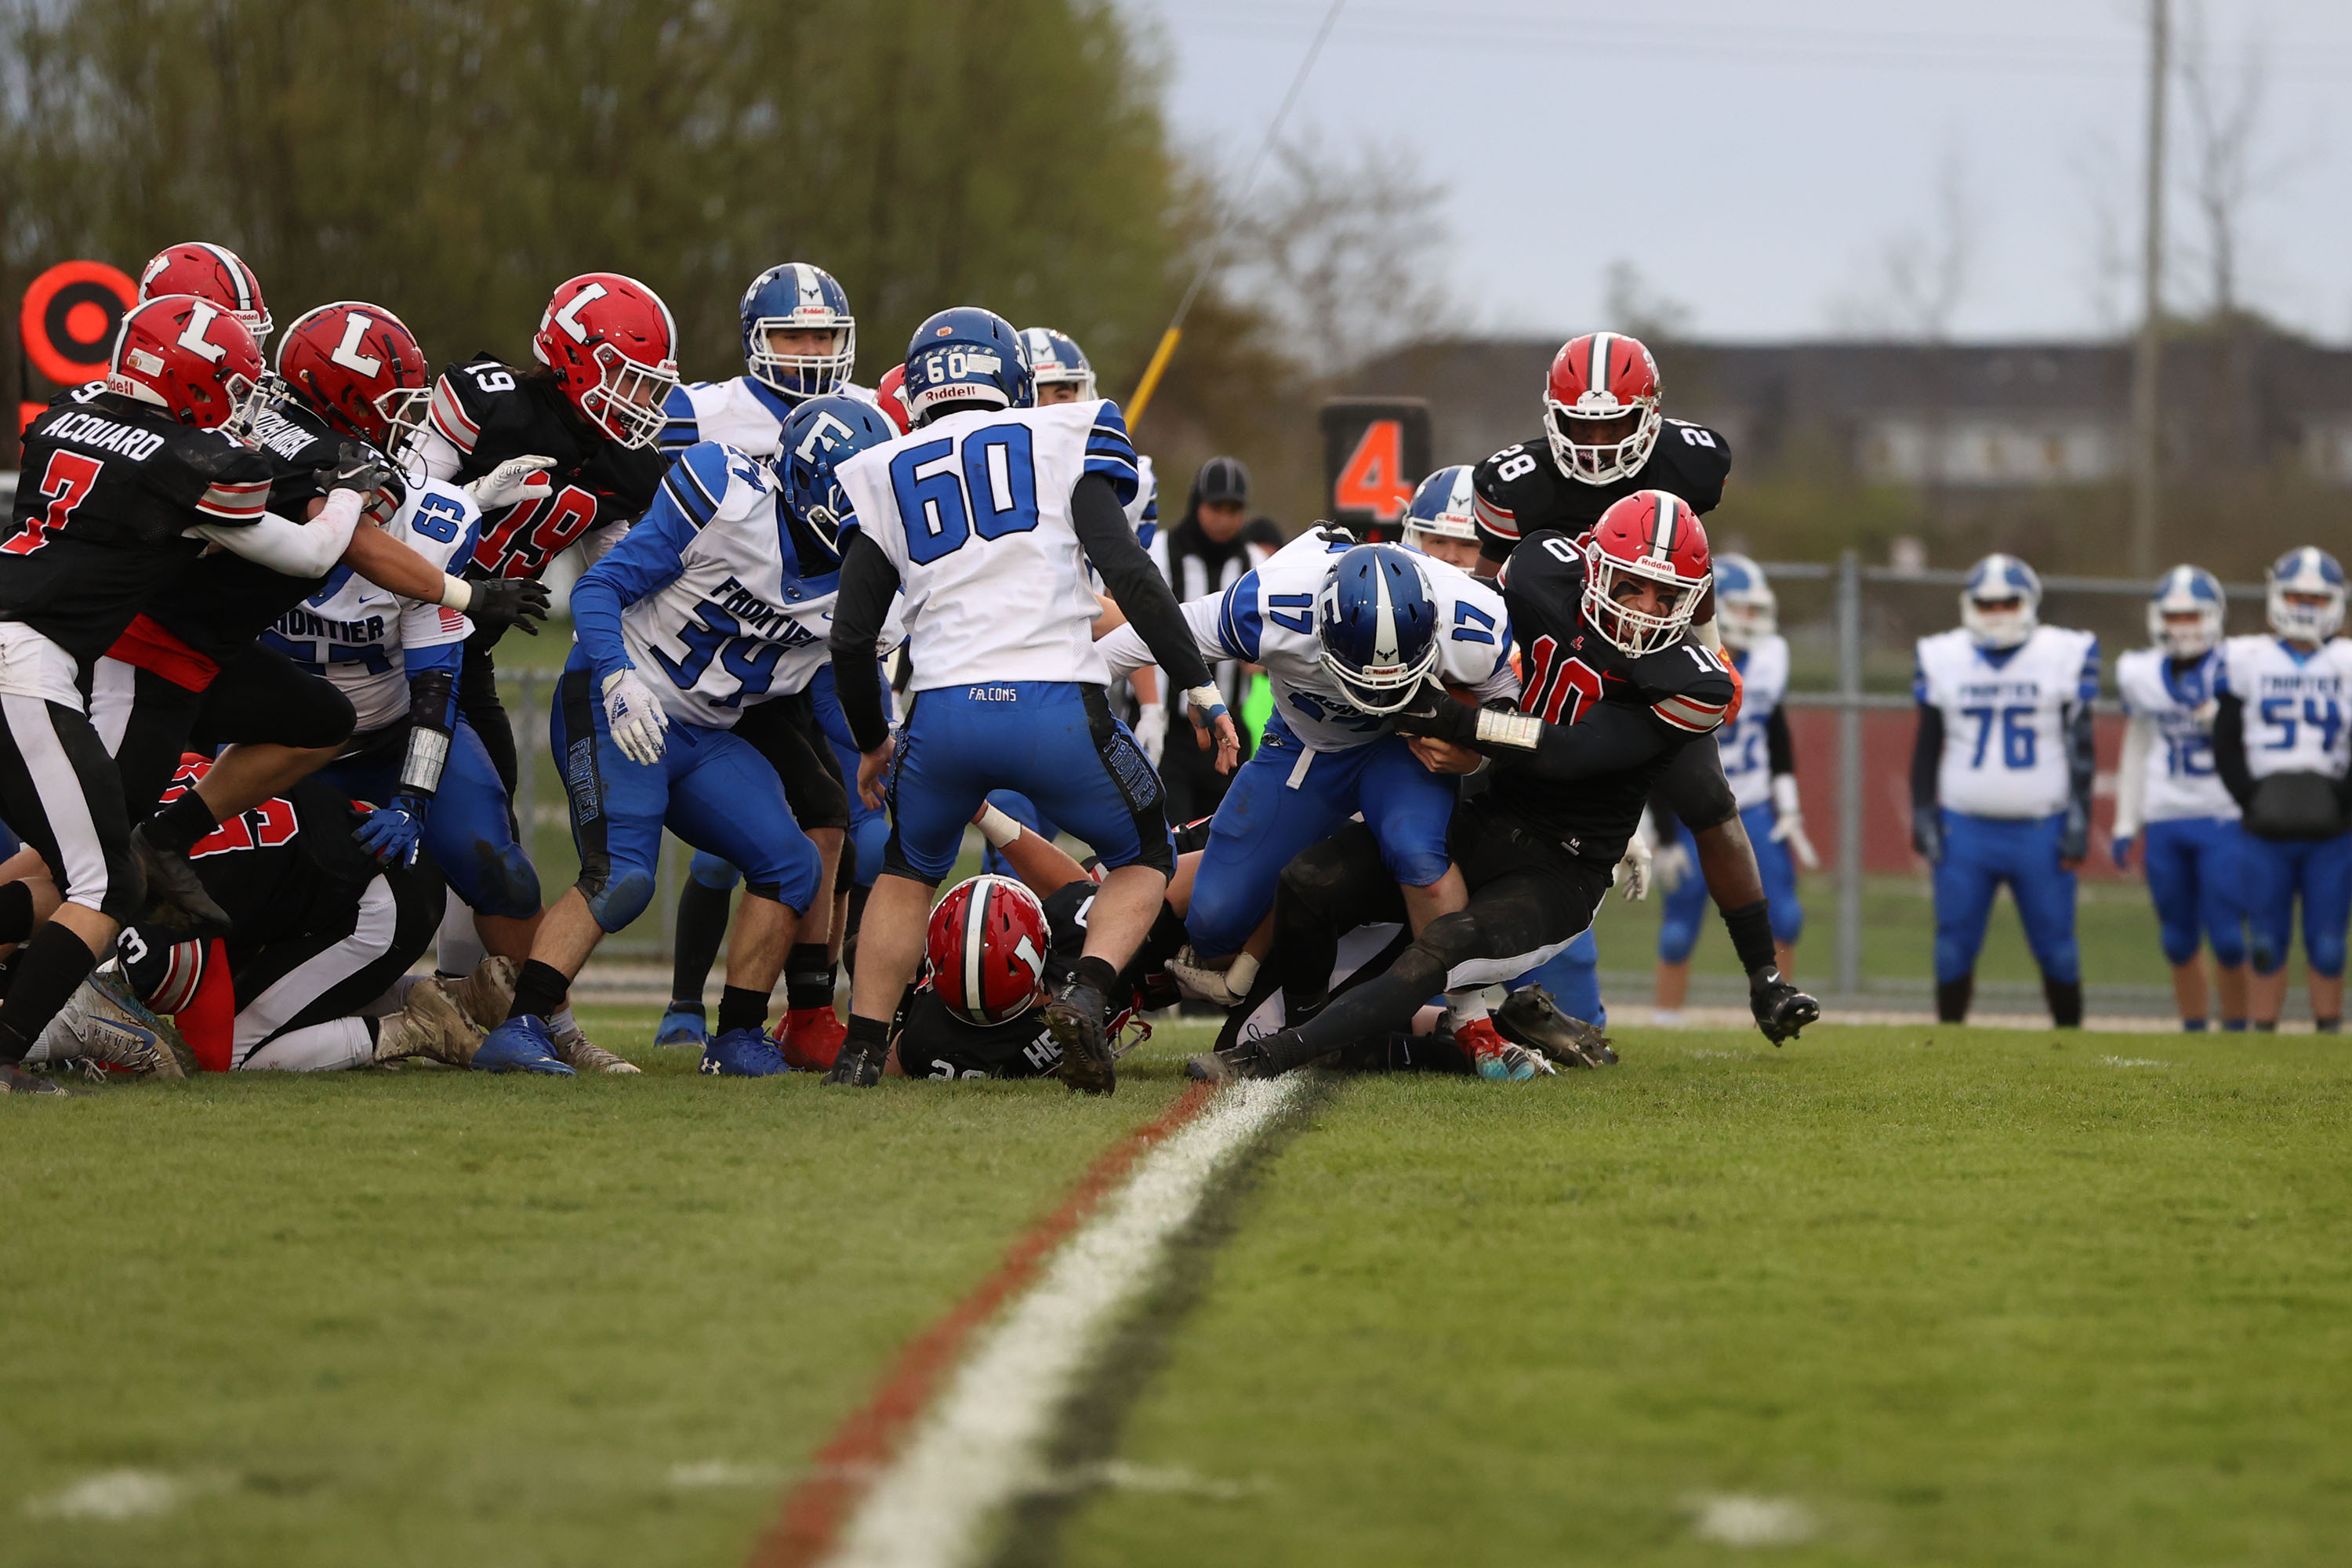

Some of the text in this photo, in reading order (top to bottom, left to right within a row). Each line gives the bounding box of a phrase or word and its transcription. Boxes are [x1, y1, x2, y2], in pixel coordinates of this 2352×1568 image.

[176, 301, 227, 364] L
[554, 282, 608, 344] L
[331, 312, 382, 379] L
[927, 353, 967, 384] 60
[463, 361, 516, 393] 19
[926, 386, 975, 402] Riddell
[41, 412, 165, 462] ACQUARD
[794, 410, 855, 465] F
[1487, 444, 1537, 482] 28
[888, 423, 1040, 567] 60
[1336, 419, 1414, 524] 4
[0, 448, 105, 556] 7
[412, 492, 466, 544] 63
[473, 468, 597, 579] 19
[1641, 557, 1673, 572] Riddell
[1269, 593, 1313, 635] 17
[1450, 600, 1496, 646] 17
[648, 598, 793, 708] 34
[1519, 633, 1604, 727] 10
[611, 693, 621, 725] adidas
[968, 687, 1017, 702] FALCONS
[1961, 706, 2037, 768] 76
[2260, 698, 2343, 752] 54
[569, 737, 598, 826] FRONTIER
